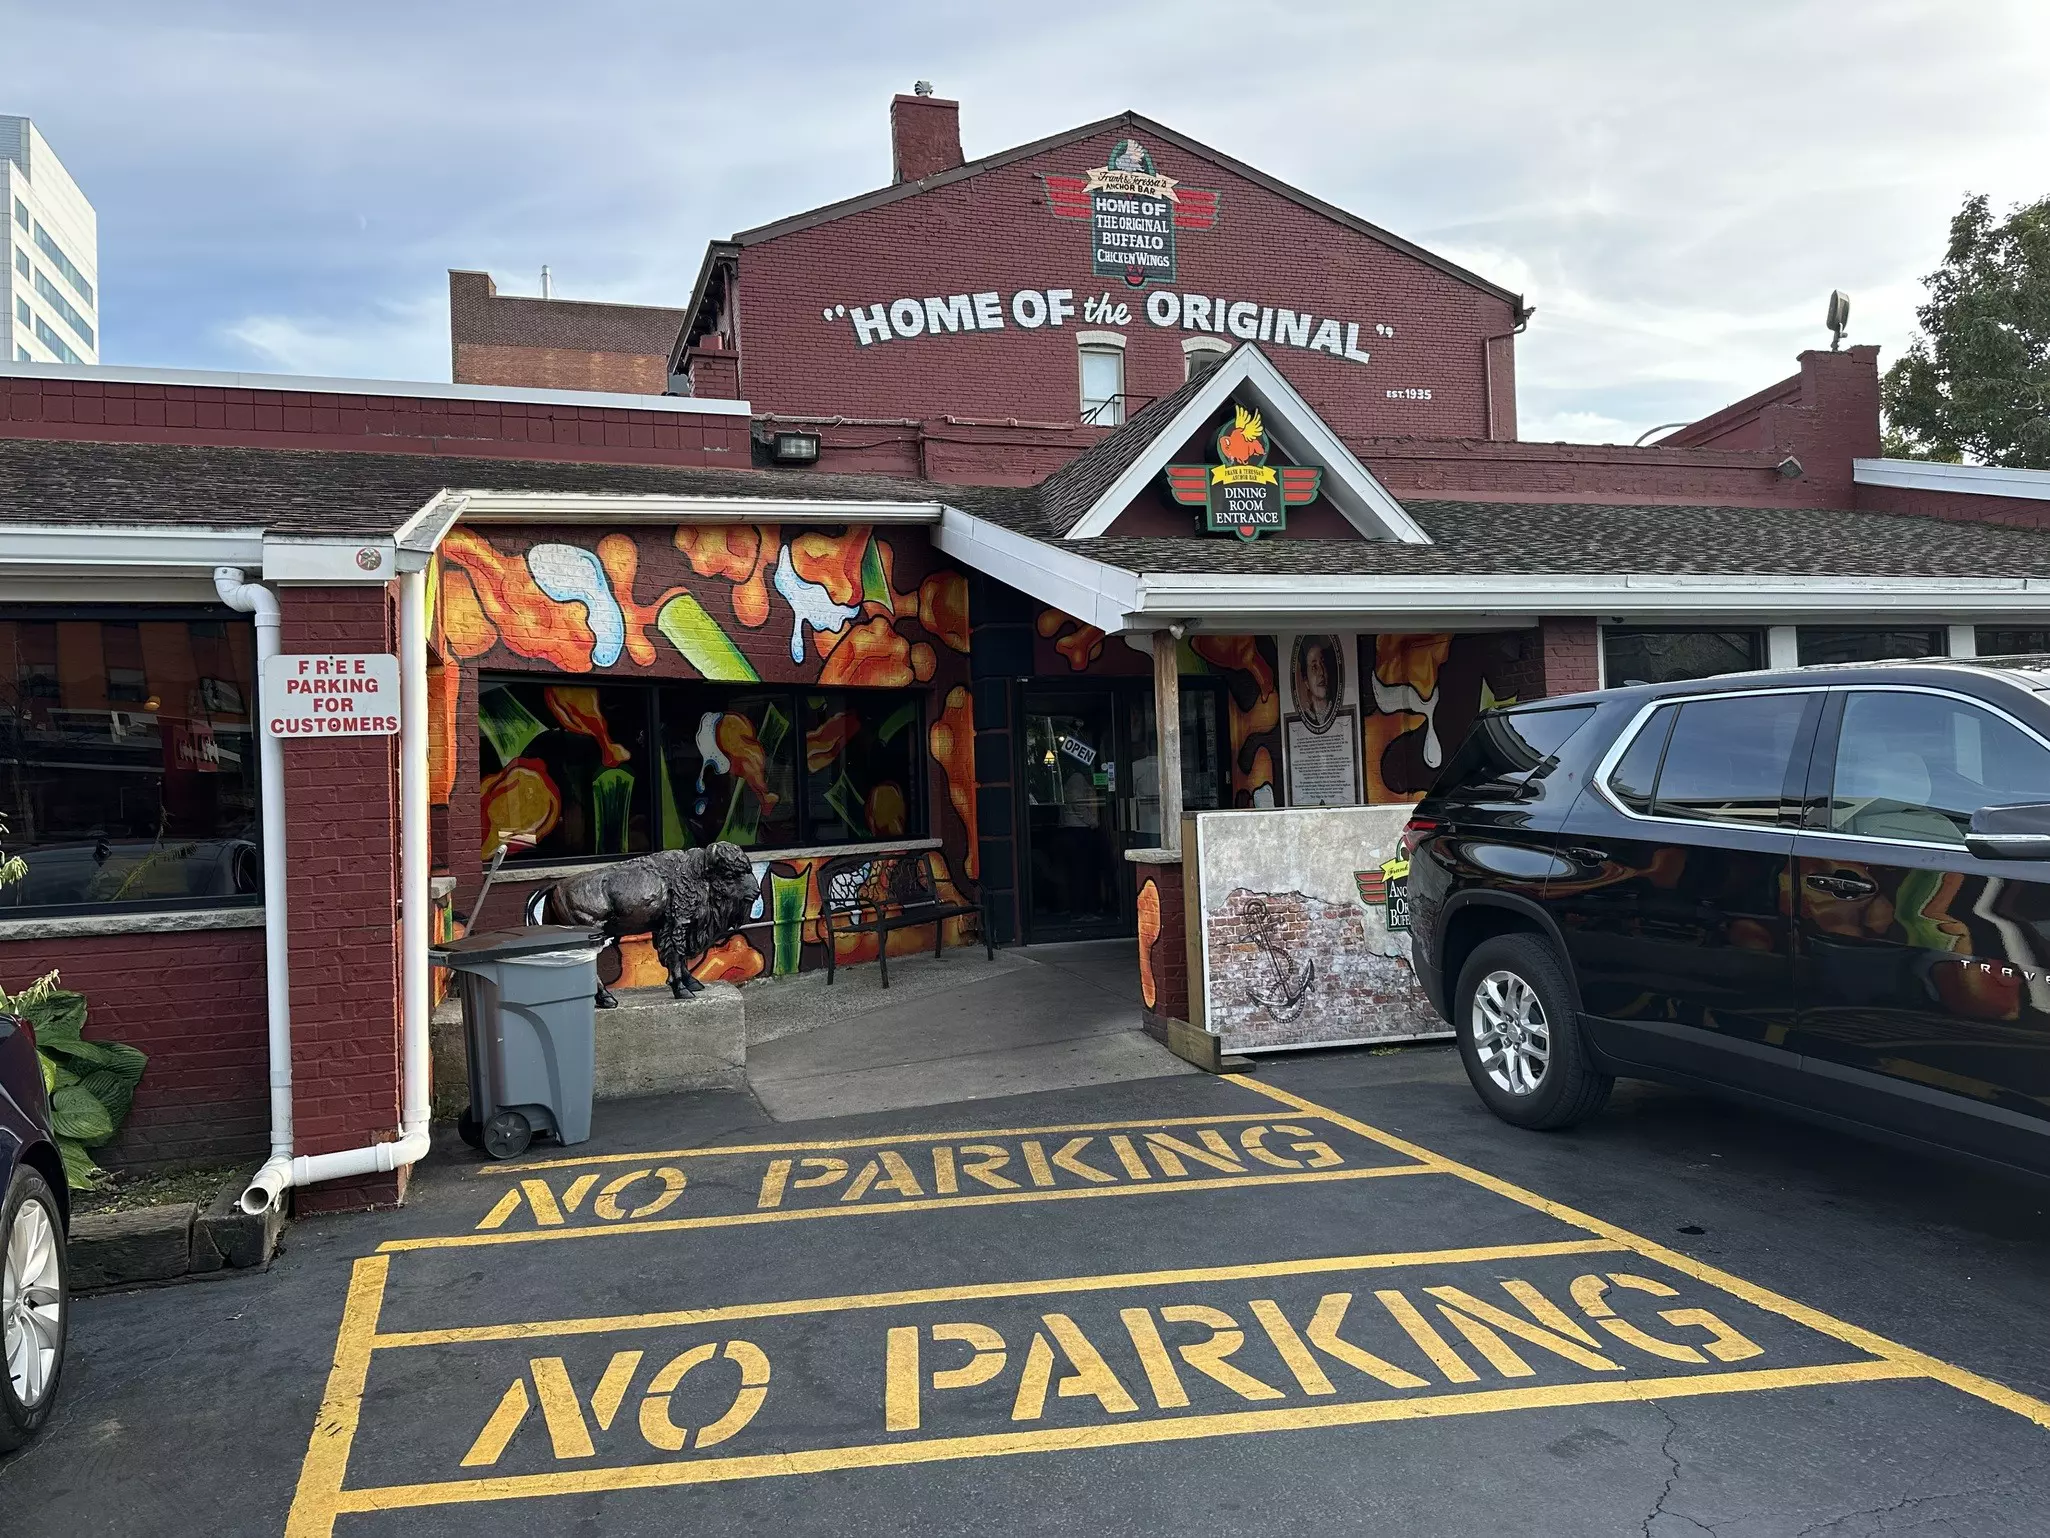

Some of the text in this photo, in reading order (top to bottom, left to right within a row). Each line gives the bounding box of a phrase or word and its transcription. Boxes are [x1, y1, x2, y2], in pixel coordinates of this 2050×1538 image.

[1098, 172, 1123, 182] Frank
[1130, 175, 1167, 188] Teressa's
[1106, 183, 1156, 195] ANCHOR BAR
[1096, 197, 1167, 216] HOME OF
[1096, 215, 1169, 233] THE ORIGINAL
[1102, 232, 1164, 249] BUFFALO
[1012, 289, 1074, 328] OF
[1083, 292, 1132, 326] the
[1224, 487, 1267, 499] DINING
[1229, 500, 1264, 511] ROOM
[1215, 512, 1279, 523] ENTRANCE
[298, 660, 366, 675] FREE
[287, 678, 379, 694] PARKING
[313, 698, 354, 712] FOR
[270, 716, 398, 734] CUSTOMERS
[1064, 739, 1094, 764] OPEN
[476, 1125, 1346, 1230] NO PARKING
[459, 1273, 1764, 1467] NO PARKING
